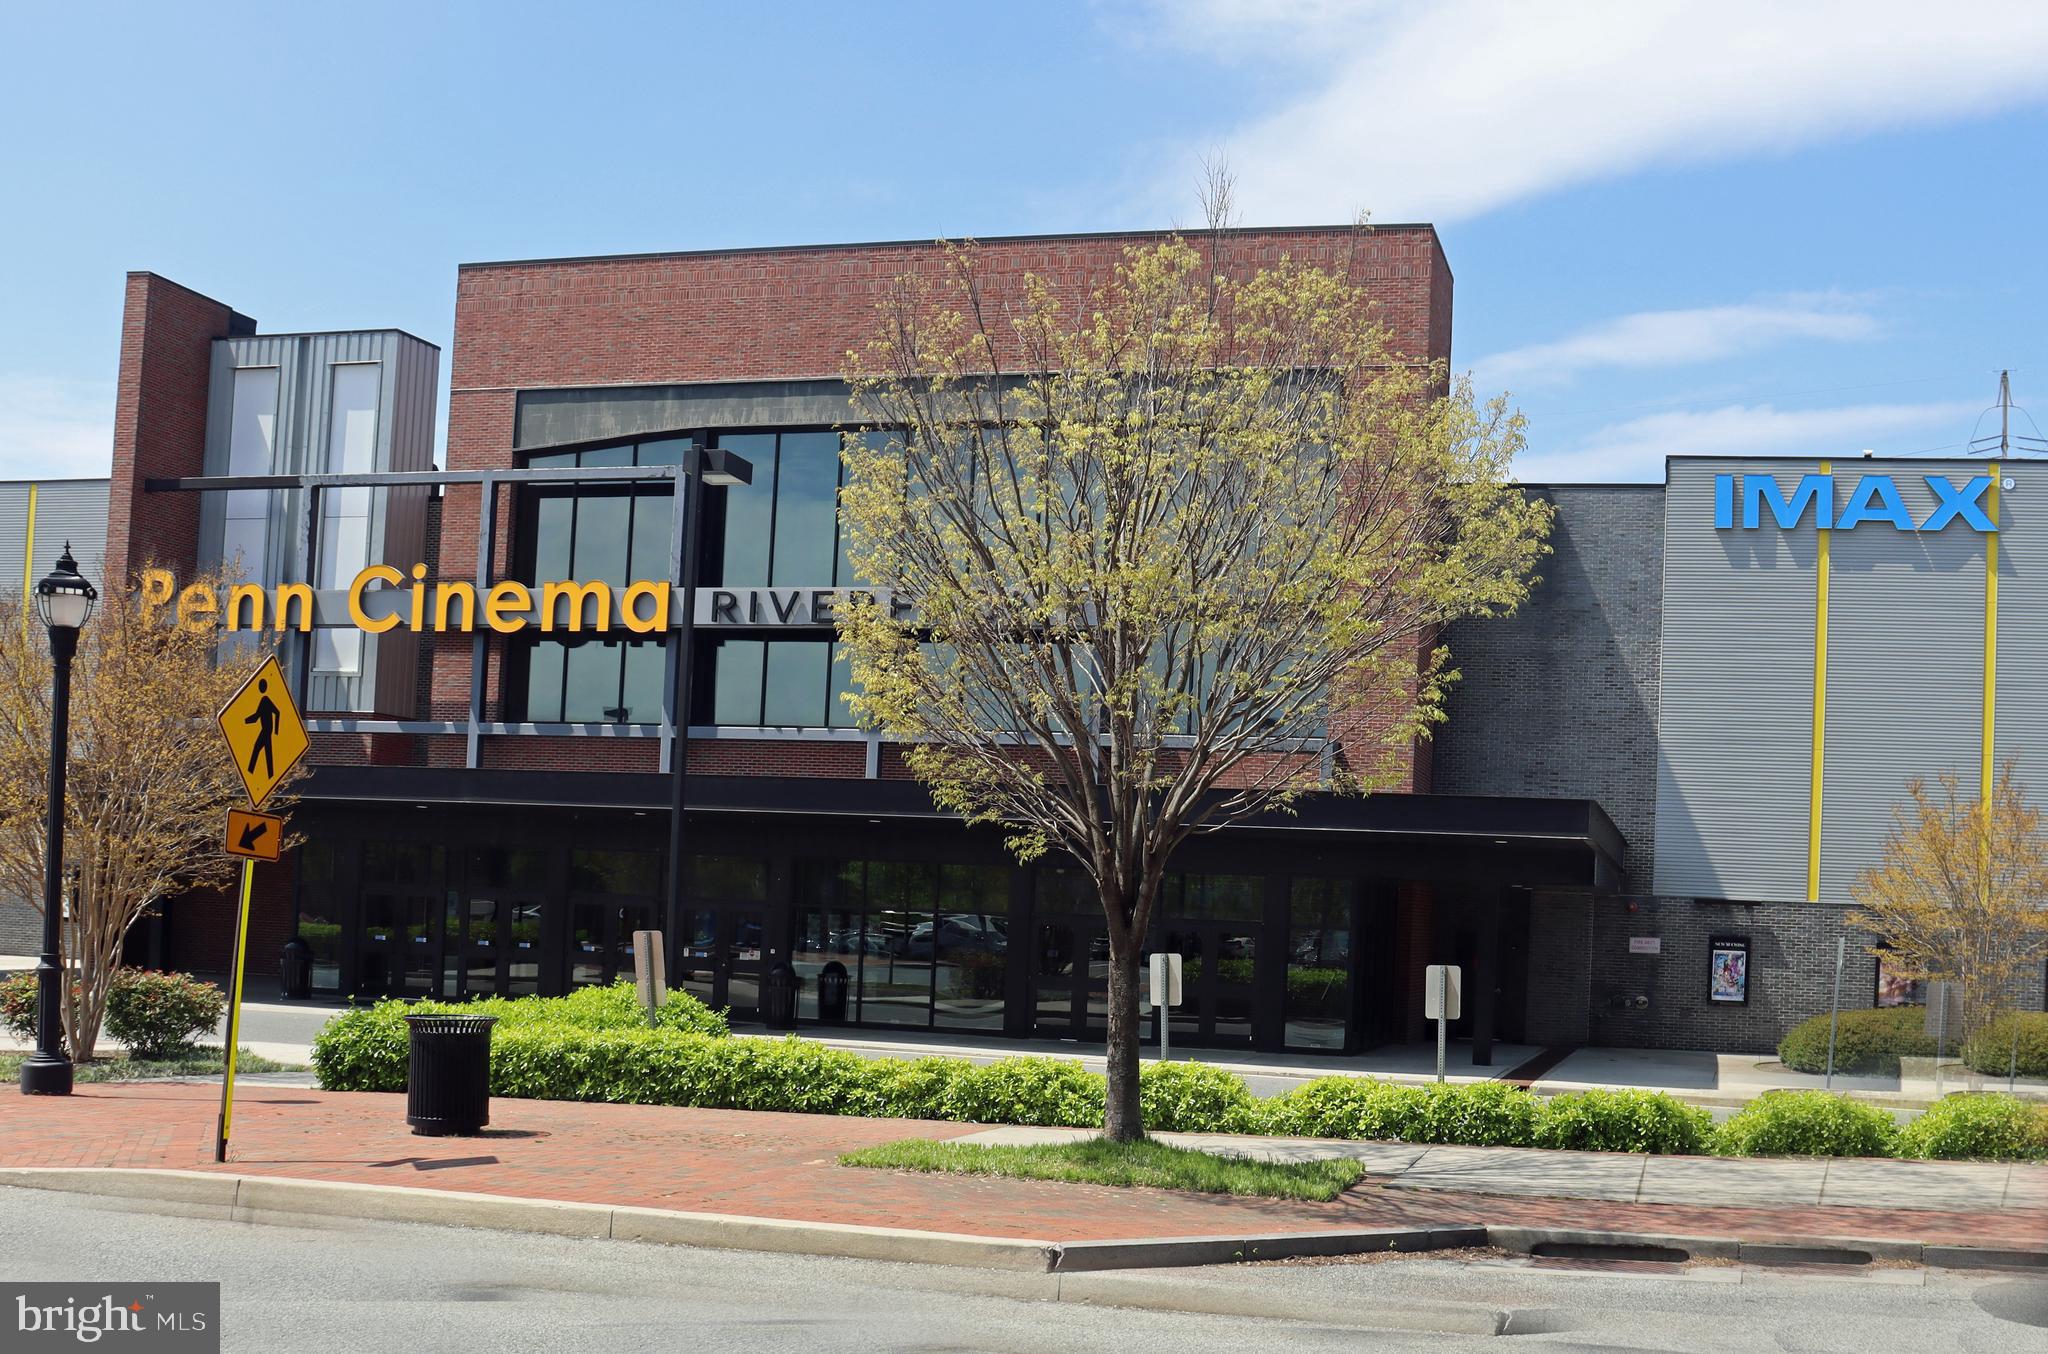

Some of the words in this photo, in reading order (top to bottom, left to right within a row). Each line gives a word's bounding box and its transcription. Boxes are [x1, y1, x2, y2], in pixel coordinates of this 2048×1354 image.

[1715, 475, 1999, 532] IMAX
[142, 568, 313, 632] Penn
[347, 562, 671, 634] Cinema
